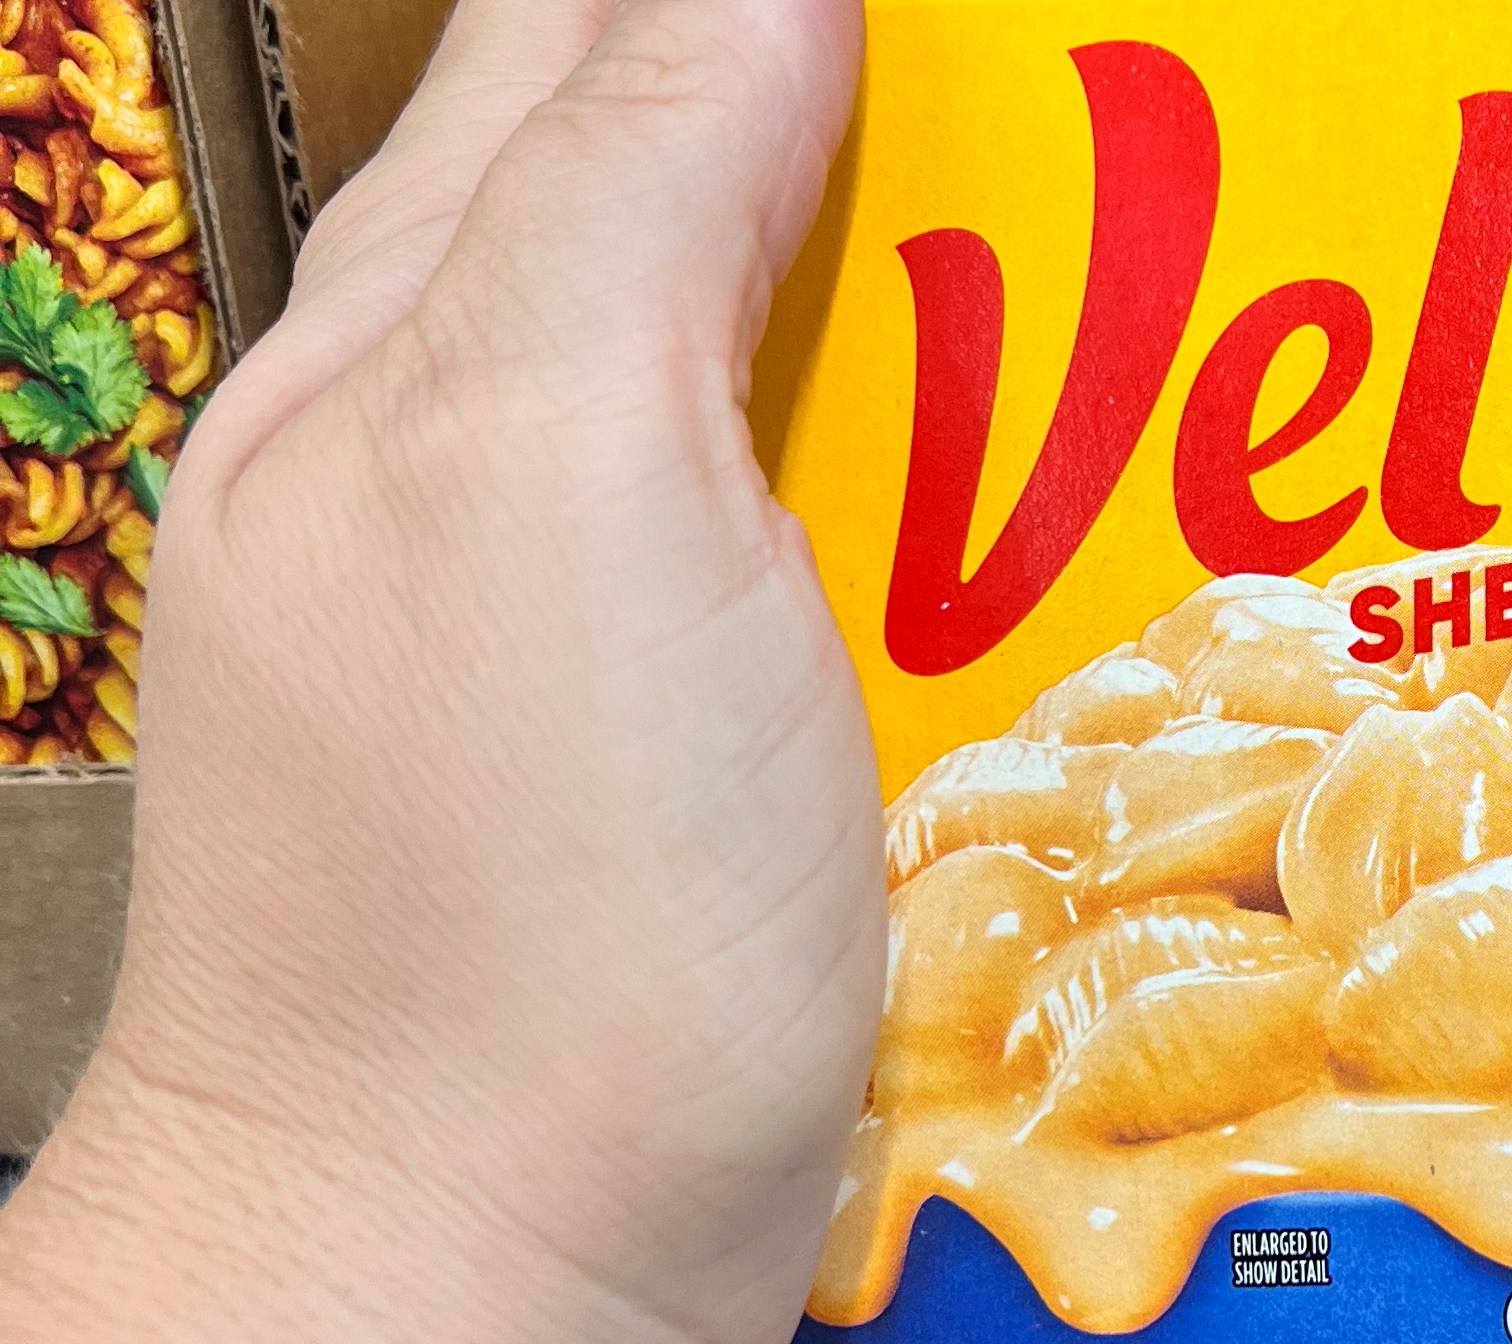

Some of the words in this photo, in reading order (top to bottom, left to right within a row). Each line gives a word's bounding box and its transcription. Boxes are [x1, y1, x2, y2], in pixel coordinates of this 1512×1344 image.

[1233, 1231, 1308, 1257] ENLARGED
[1310, 1230, 1329, 1255] TO
[1234, 1260, 1278, 1285] SHOW
[1280, 1259, 1330, 1284] DETAIL
